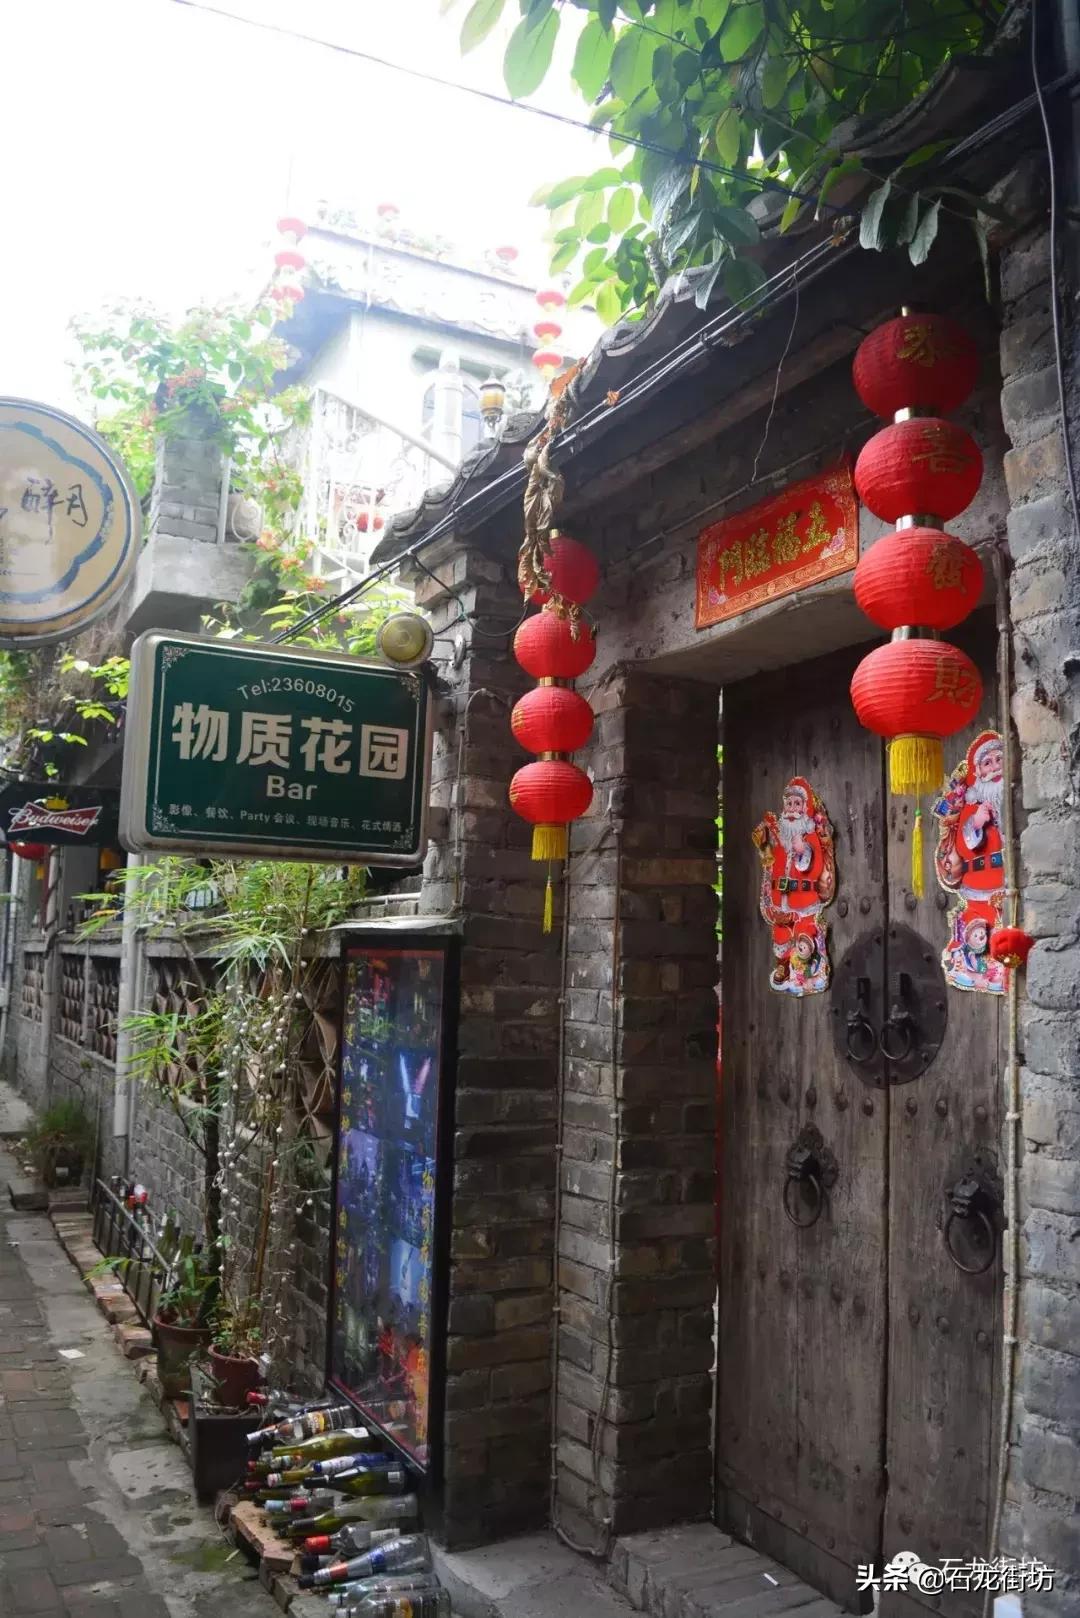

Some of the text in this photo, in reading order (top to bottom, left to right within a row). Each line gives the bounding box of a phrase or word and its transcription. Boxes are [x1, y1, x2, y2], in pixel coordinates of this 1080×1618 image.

[237, 677, 356, 714] Tel:23608015
[171, 702, 409, 781] 物质花园
[266, 775, 318, 801] Bar
[8, 807, 99, 827] Budweiser
